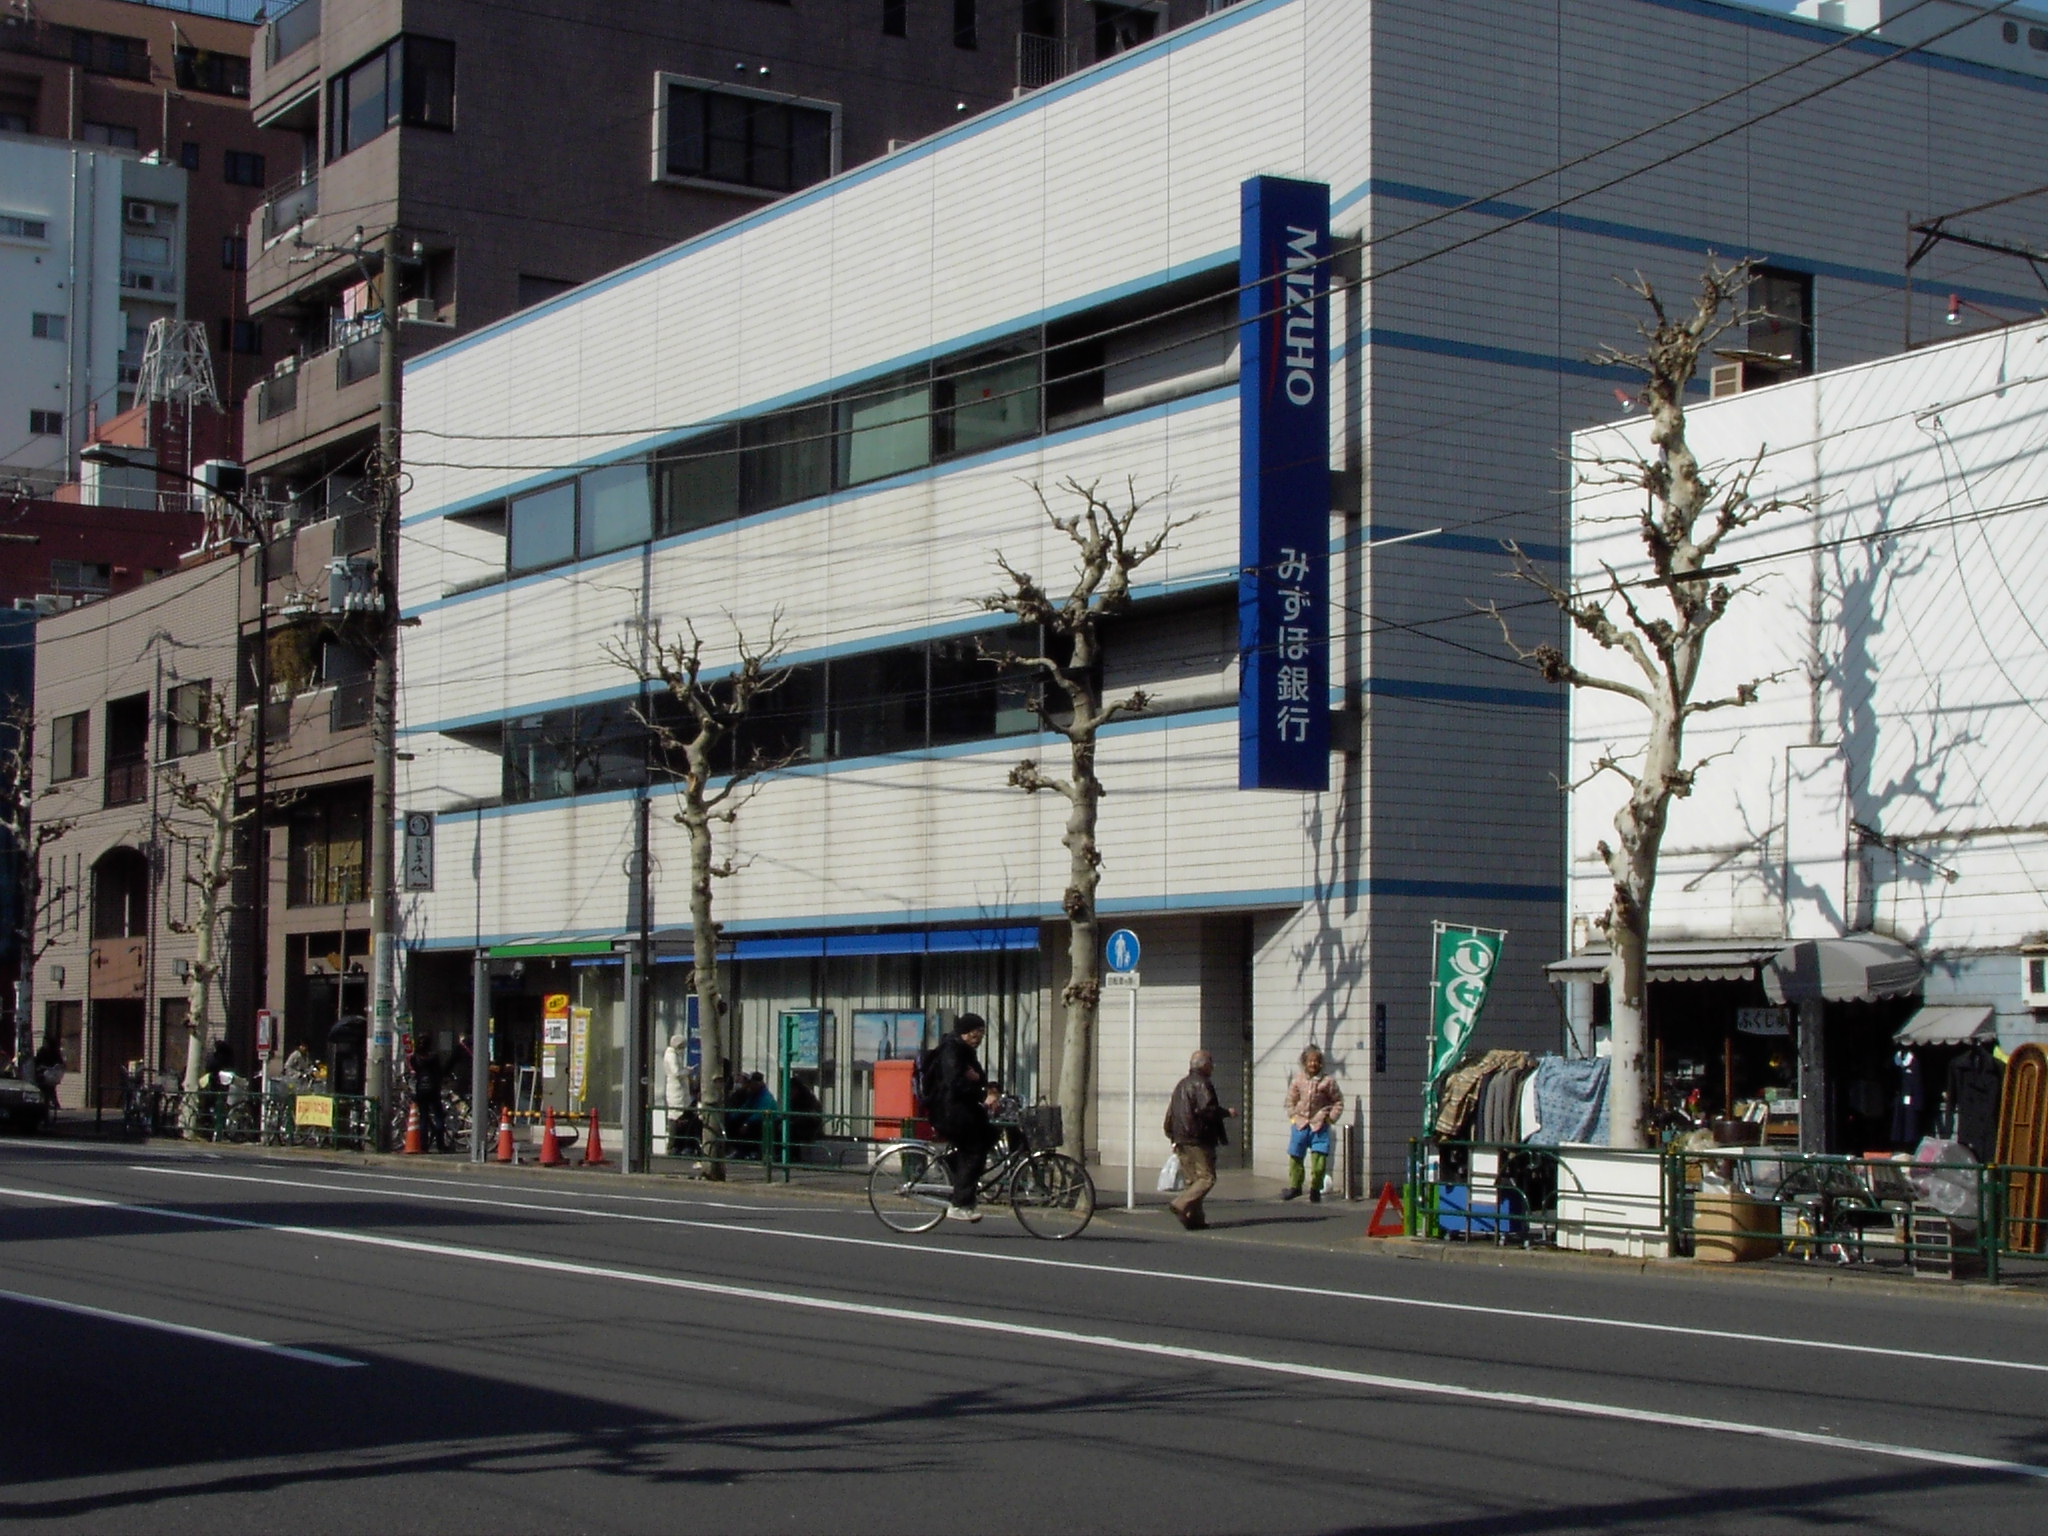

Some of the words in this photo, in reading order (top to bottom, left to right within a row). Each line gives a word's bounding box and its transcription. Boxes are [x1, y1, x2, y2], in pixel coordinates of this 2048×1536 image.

[1286, 225, 1317, 406] MIZUHO
[1277, 548, 1311, 742] みずほ銀行
